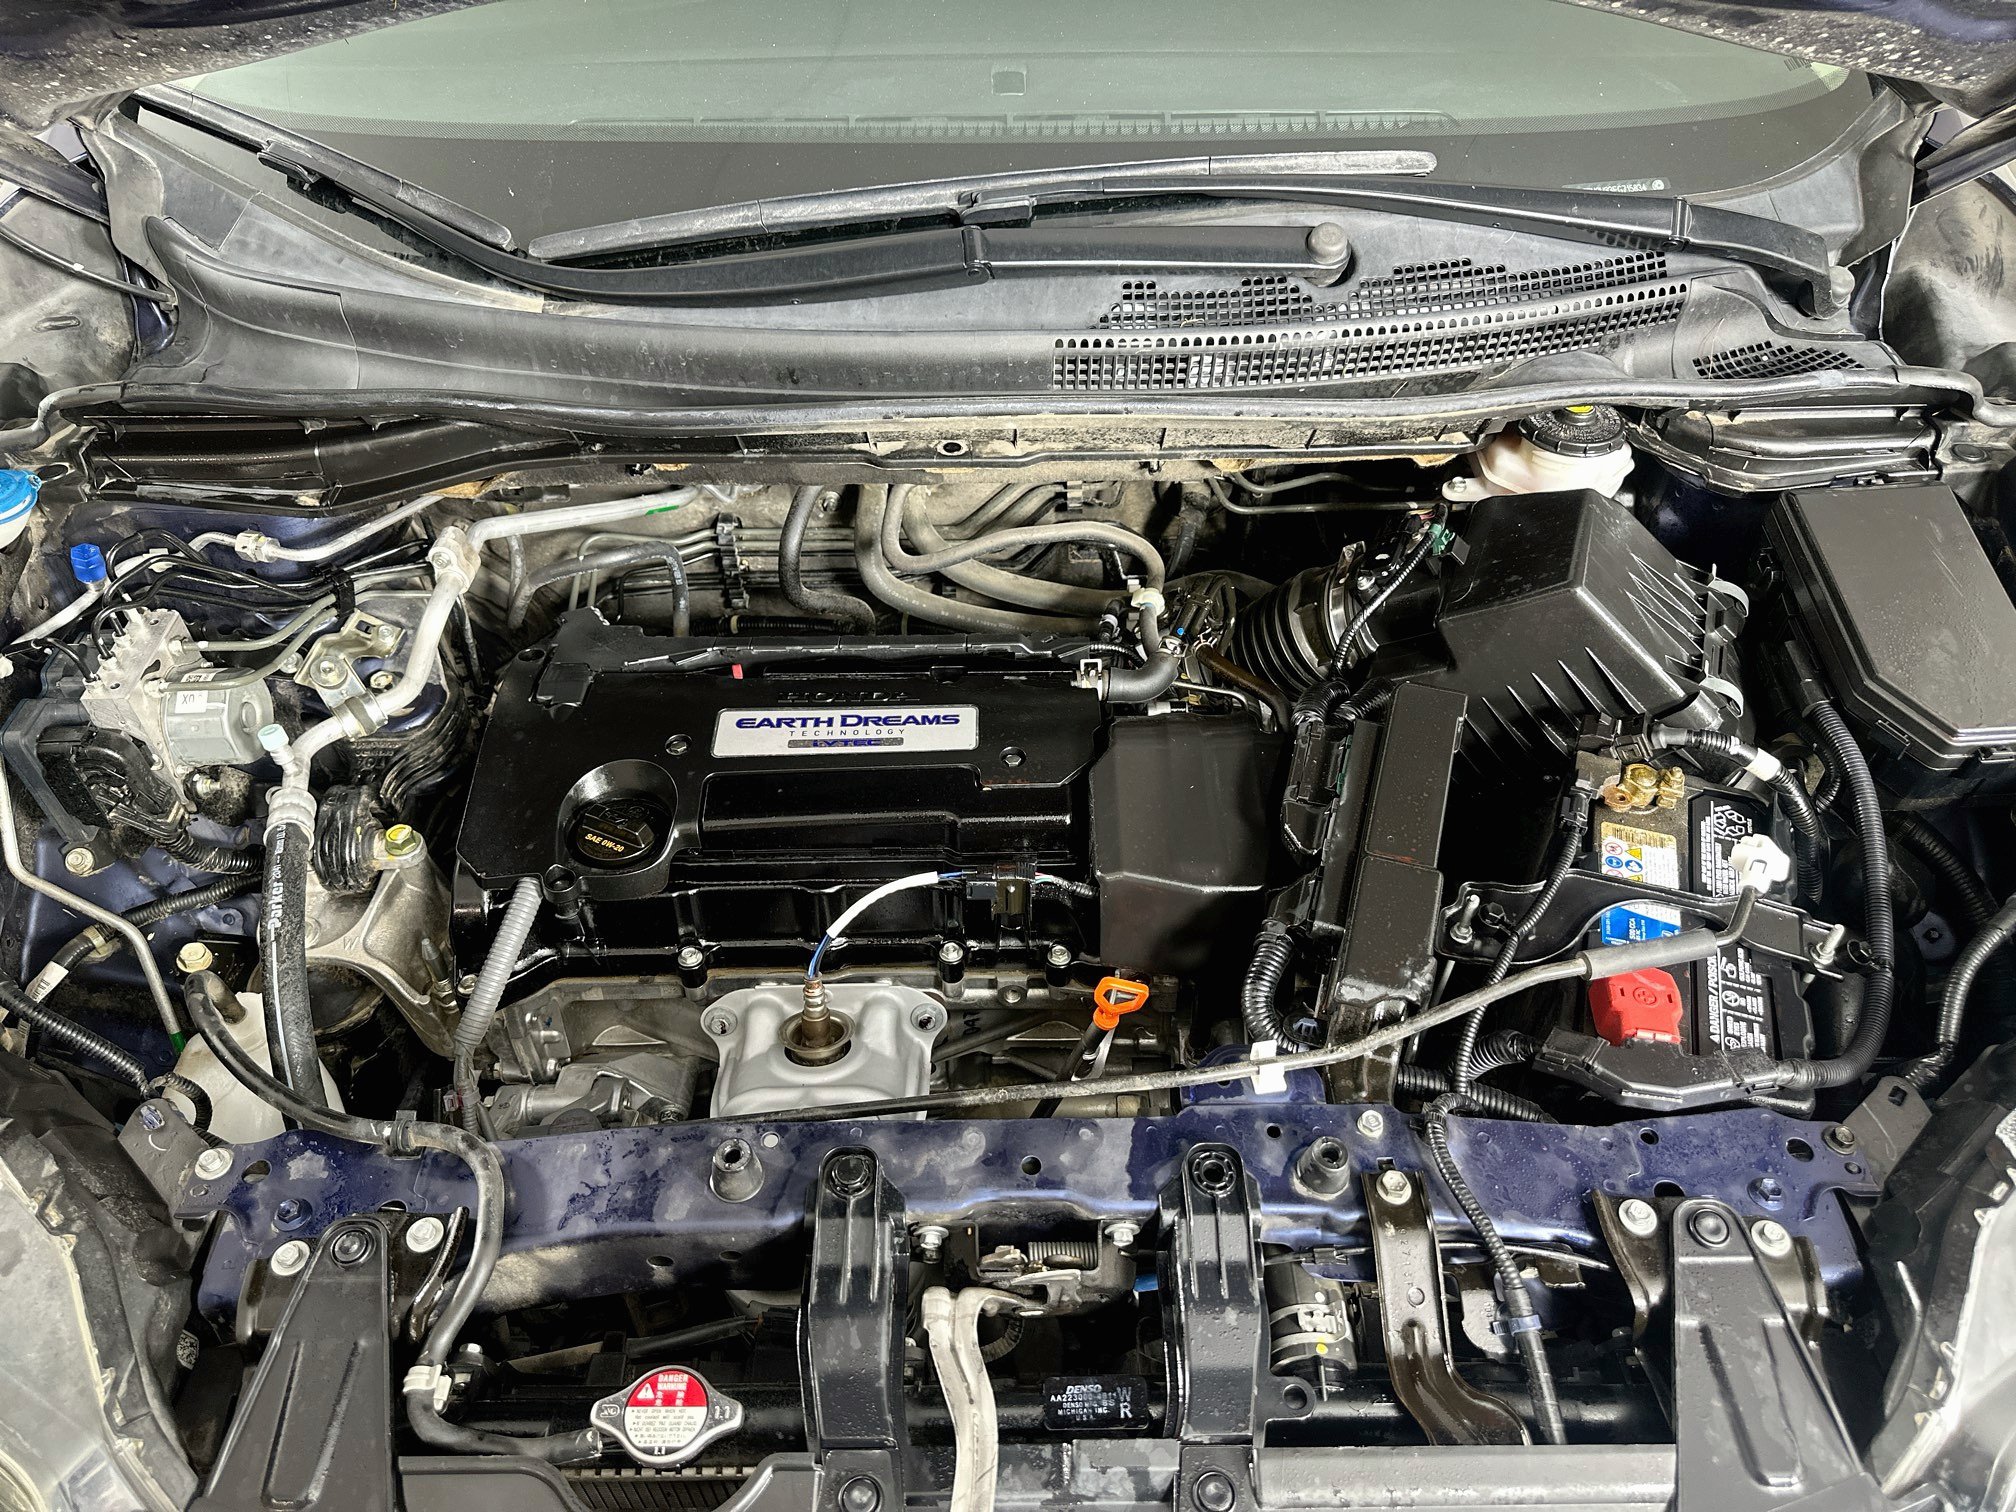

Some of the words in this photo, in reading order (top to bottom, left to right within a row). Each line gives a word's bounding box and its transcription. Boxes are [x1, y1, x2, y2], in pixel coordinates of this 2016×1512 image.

[735, 716, 834, 729] EARTH
[840, 714, 961, 728] DREAMS
[789, 728, 906, 737] TECHNOLOGY
[584, 833, 602, 844] SAE
[601, 840, 625, 852] 0W-20
[267, 881, 284, 930] Parker
[658, 1374, 689, 1382] DANGER
[1066, 1384, 1103, 1394] DENSO
[1117, 1386, 1132, 1402] W
[1119, 1402, 1133, 1419] R
